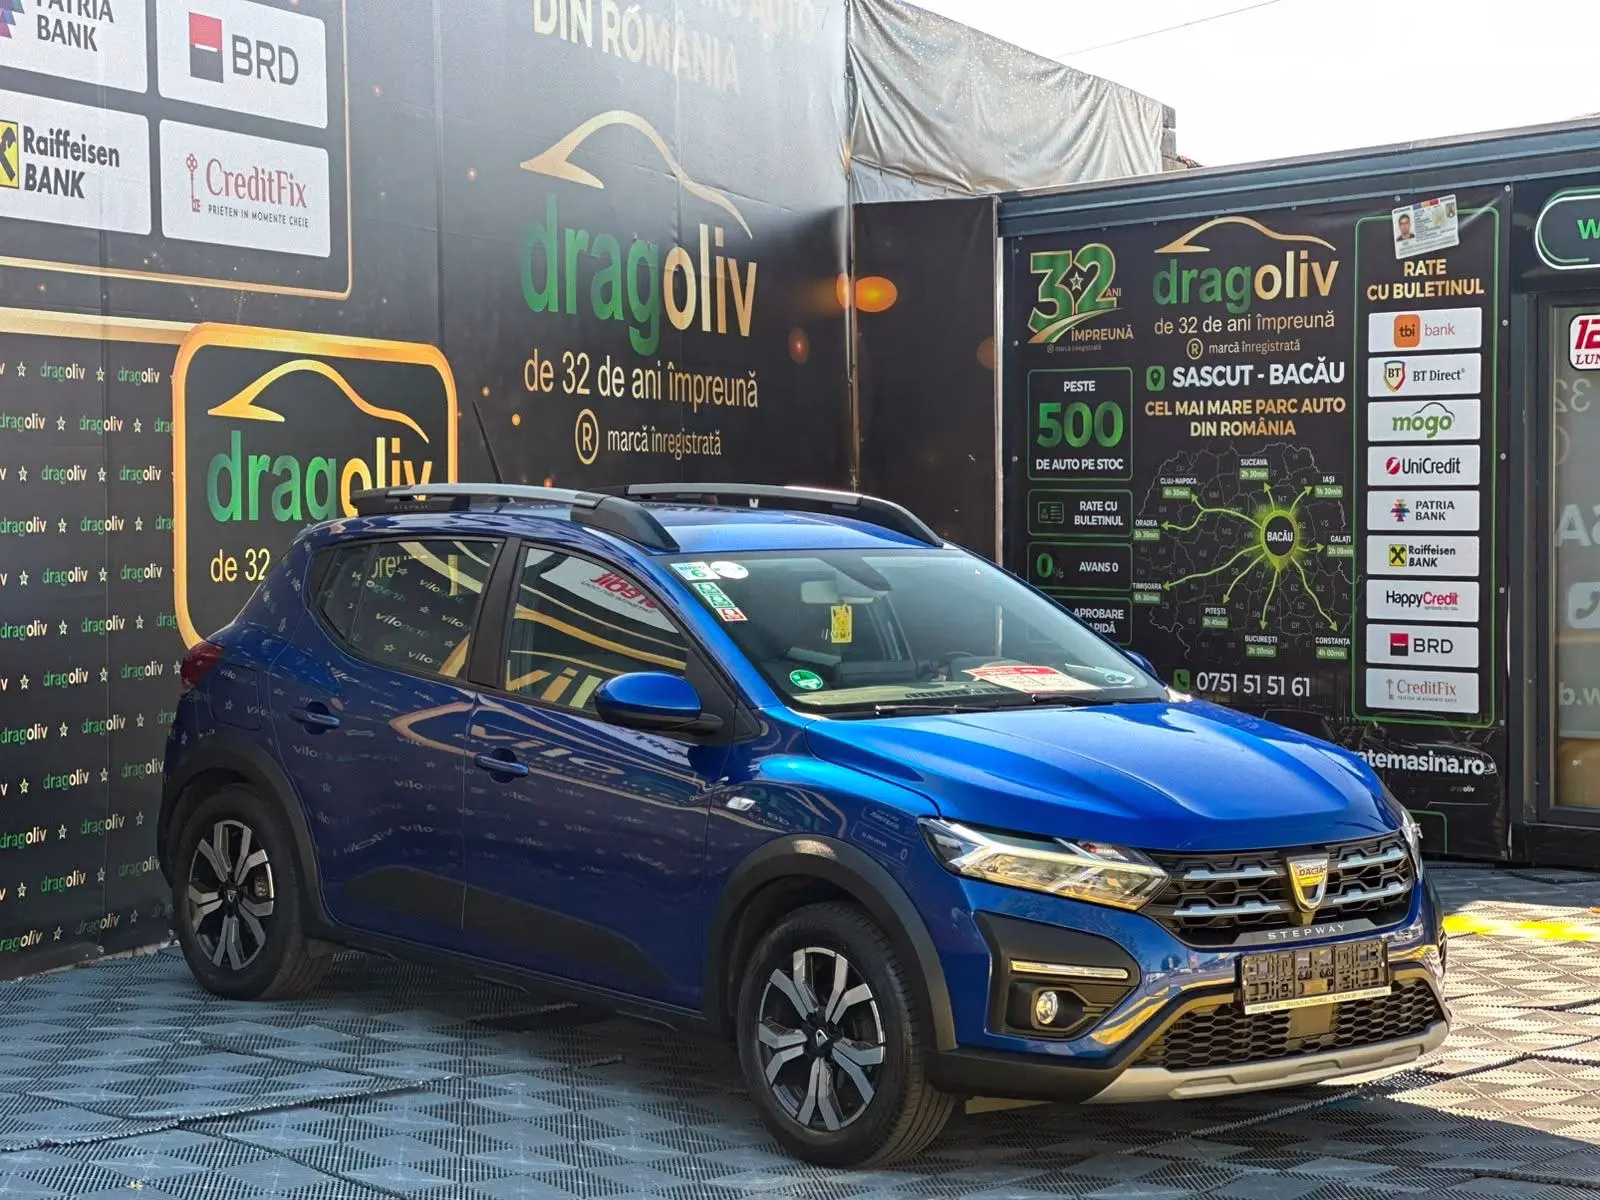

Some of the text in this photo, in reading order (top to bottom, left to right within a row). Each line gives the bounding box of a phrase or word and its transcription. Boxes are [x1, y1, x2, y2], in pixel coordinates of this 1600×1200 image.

[37, 14, 99, 53] BANK
[533, 0, 593, 48] DIN
[231, 34, 299, 86] BRD
[23, 126, 121, 168] Raiffeisen
[24, 163, 86, 200] BANK
[206, 158, 308, 209] CreditFix
[208, 203, 309, 228] PRIETEN IN MOMENTE CHEIE
[519, 192, 758, 356] dragoliv
[1403, 258, 1447, 277] RATE
[1028, 243, 1122, 334] 32 ANI
[1153, 250, 1339, 314] dragoliv
[1366, 278, 1485, 301] CU BULETINUL
[1071, 324, 1134, 342] ÎMPREUNĂ
[1154, 310, 1335, 335] de 32 de ani împreună
[1399, 323, 1456, 338] tbi bank
[1208, 341, 1240, 355] marcă
[1241, 339, 1301, 356] înregistrată
[40, 361, 85, 383] dragoliv
[118, 366, 160, 386] dragoliv
[524, 349, 758, 413] de 32 de ani împreună
[1172, 364, 1254, 389] SASCUT
[1269, 356, 1345, 386] BACĂU
[1387, 368, 1401, 379] BT
[1412, 370, 1428, 382] BT
[1063, 380, 1096, 393] PESTE
[1145, 397, 1346, 416] CEL MAI MARE PARC AUTO
[79, 414, 123, 435] dragoliv
[1036, 401, 1124, 448] 500
[1190, 417, 1297, 438] DIN ROMÂNIA
[1392, 413, 1452, 439] mogo
[607, 424, 649, 453] marcă
[651, 425, 722, 461] înregistrată
[1036, 458, 1124, 471] DE AUTO PE STOC
[1240, 458, 1268, 467] SUCEAVA
[1402, 457, 1461, 476] UniCredit
[41, 463, 87, 485] dragoliv
[119, 464, 162, 485] dragoliv
[1160, 476, 1197, 486] CLUJ-NAPOCA
[1079, 500, 1118, 511] RATE CU
[1415, 499, 1456, 512] PATRIA
[0, 514, 47, 537] dragoliv
[80, 513, 125, 534] dragoliv
[1074, 515, 1124, 527] BULETINUL
[1135, 519, 1158, 528] ORADEA
[1415, 511, 1446, 522] BANK
[1267, 529, 1293, 543] BACĂU
[1408, 544, 1456, 557] Raiffeisen
[120, 563, 163, 583] dragoliv
[210, 547, 271, 583] de 32
[1079, 560, 1119, 572] AVANS 0
[1408, 557, 1438, 568] BANK
[42, 566, 88, 588] dragoliv
[1132, 582, 1162, 593] TIMIȘOARA
[1386, 590, 1459, 608] HappyCredit
[1073, 608, 1125, 620] APROBARE
[0, 619, 47, 642] dragoliv
[81, 614, 125, 636] dragoliv
[1244, 635, 1278, 646] BUCUREȘTI
[1314, 637, 1351, 647] CONSTANȚA
[1413, 638, 1454, 654] BRD
[43, 666, 89, 689] dragoliv
[121, 659, 163, 680] dragoliv
[1196, 672, 1311, 698] 0751 51 51 61
[1396, 678, 1457, 696] CreditFix
[0, 722, 48, 746] dragoliv
[82, 713, 126, 736] dragoliv
[121, 756, 164, 779] dragoliv
[43, 767, 90, 791] dragoliv
[80, 812, 125, 836] dragoliv
[0, 825, 47, 850] dragoliv
[40, 869, 86, 894] dragoliv
[1299, 865, 1327, 877] DACIA
[75, 912, 121, 936] dragoliv
[1267, 923, 1346, 942] STEPWAY
